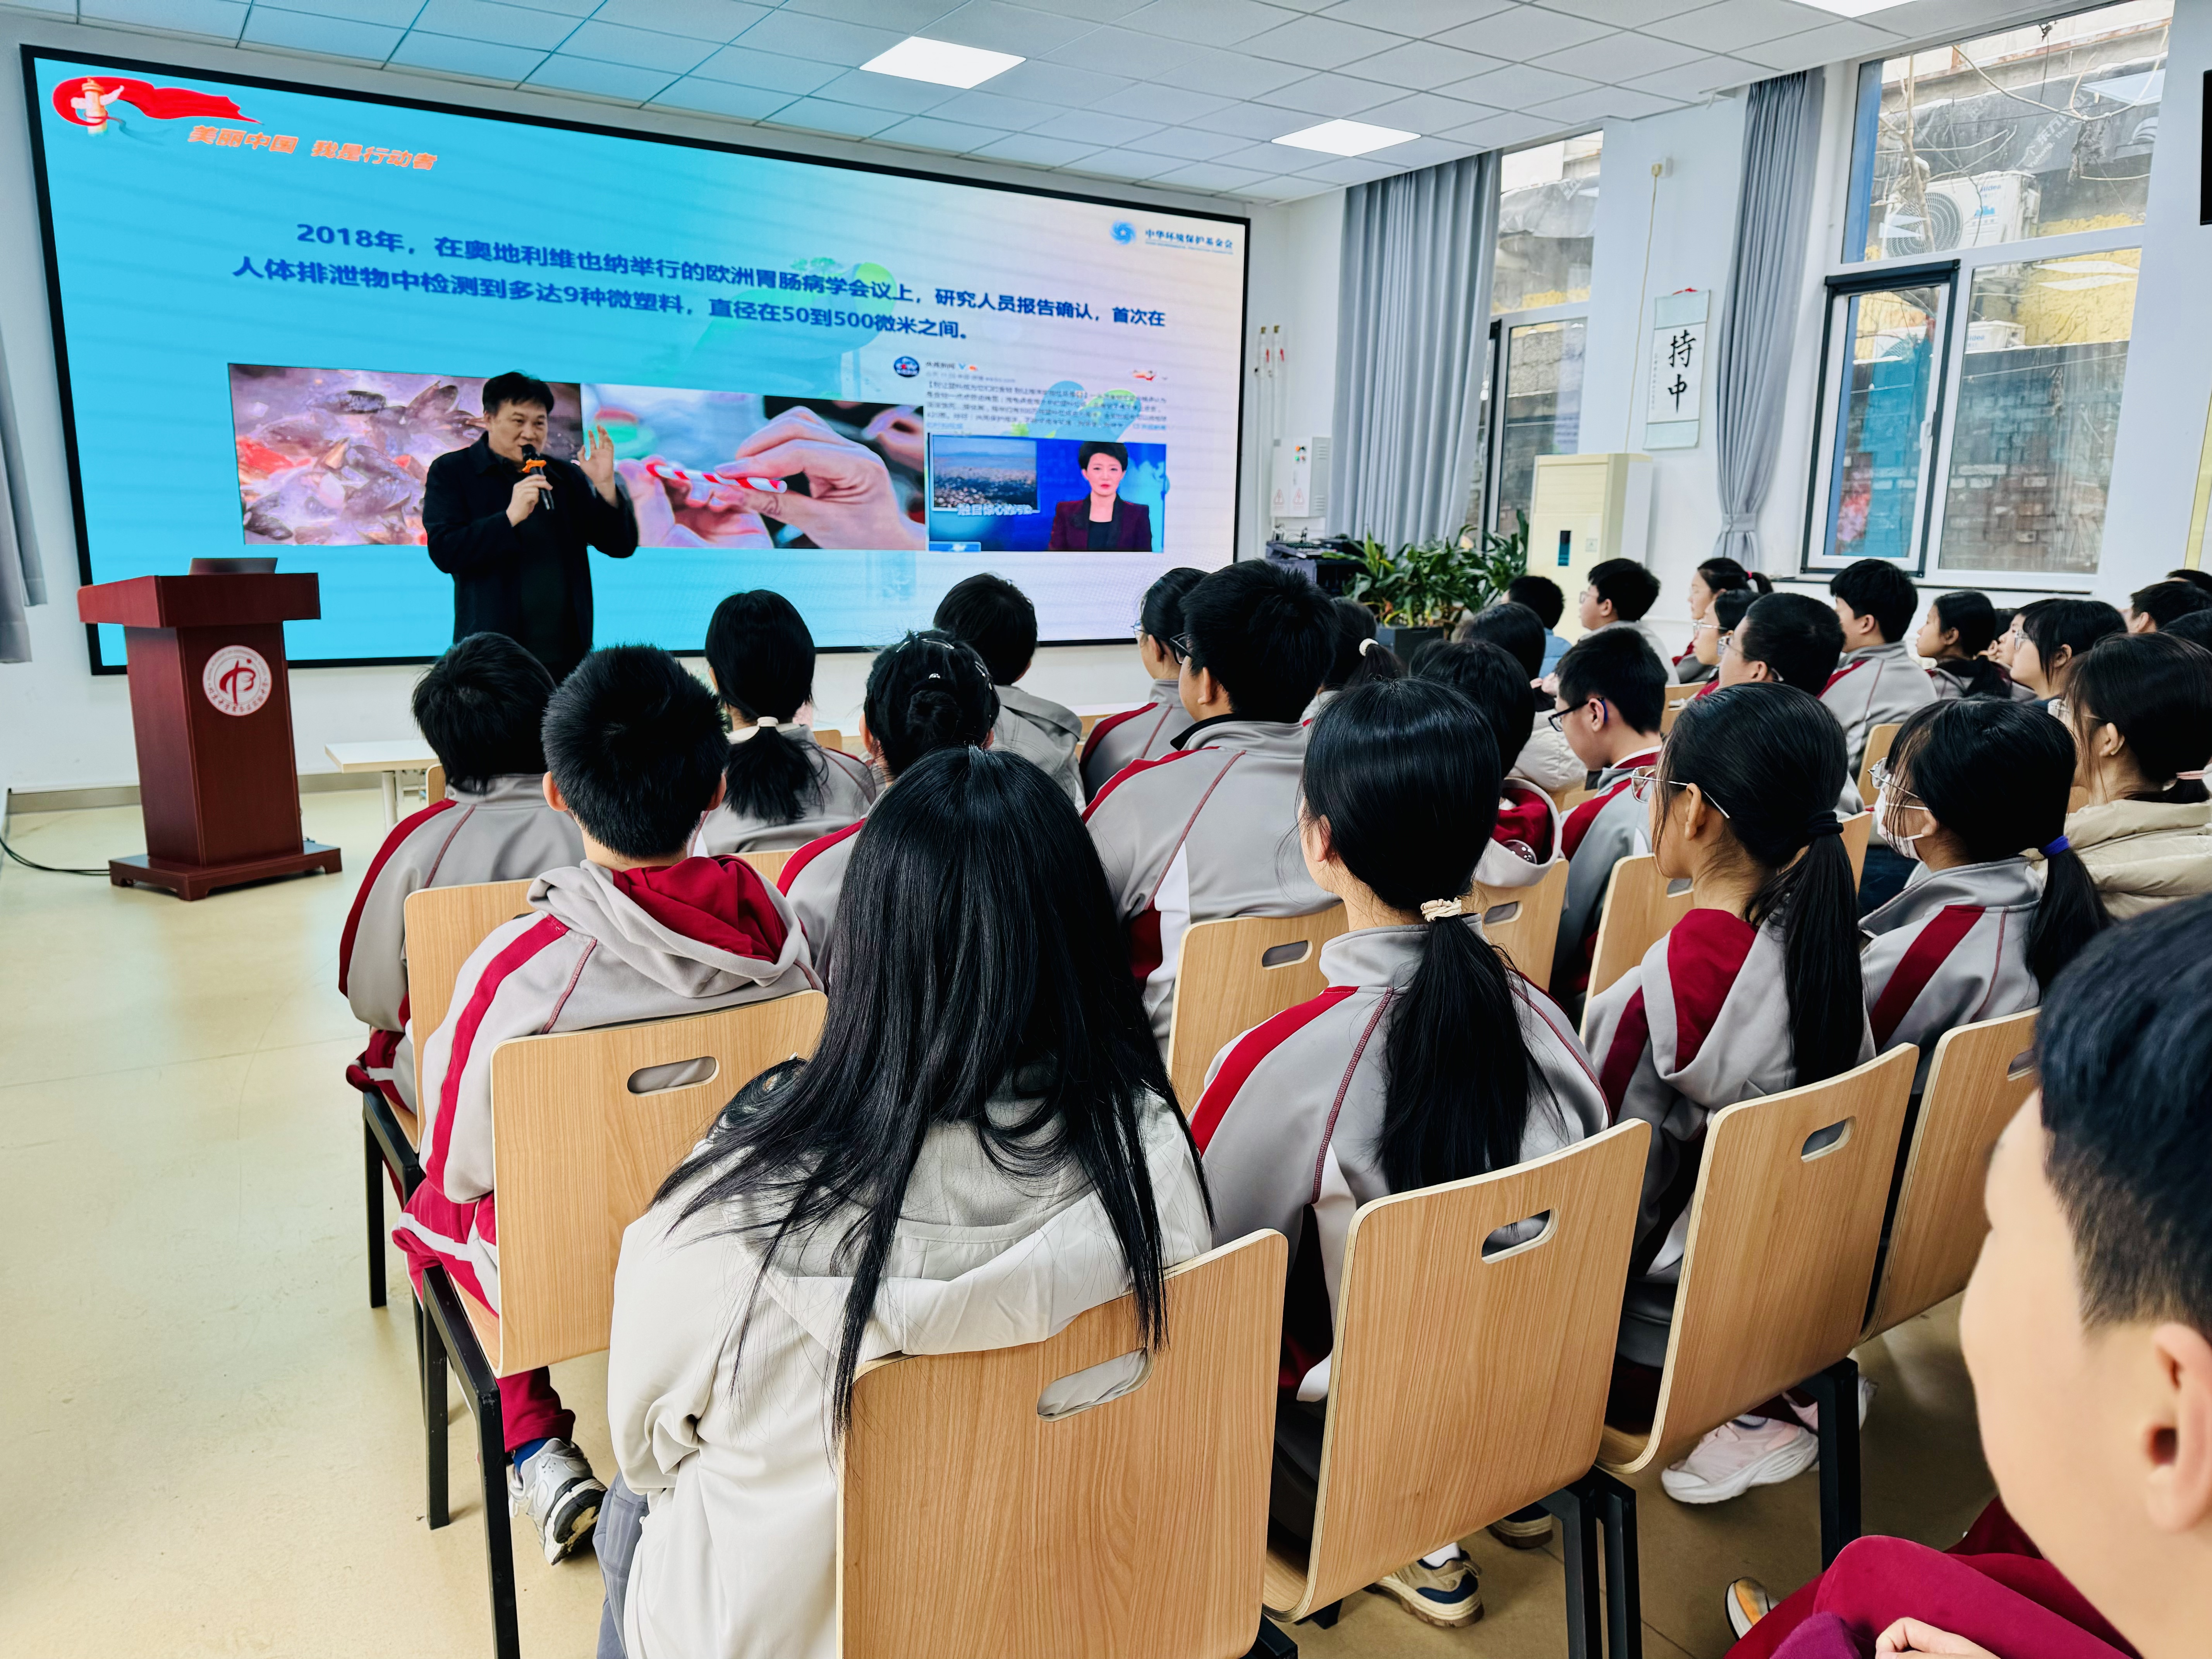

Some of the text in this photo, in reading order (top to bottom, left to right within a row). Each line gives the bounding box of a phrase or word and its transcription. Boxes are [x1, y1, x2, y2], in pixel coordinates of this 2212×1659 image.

[188, 125, 437, 170] 美丽中国 我是行动者
[1145, 229, 1232, 249] 中华环境保护基金会
[1668, 330, 1696, 413] 持中
